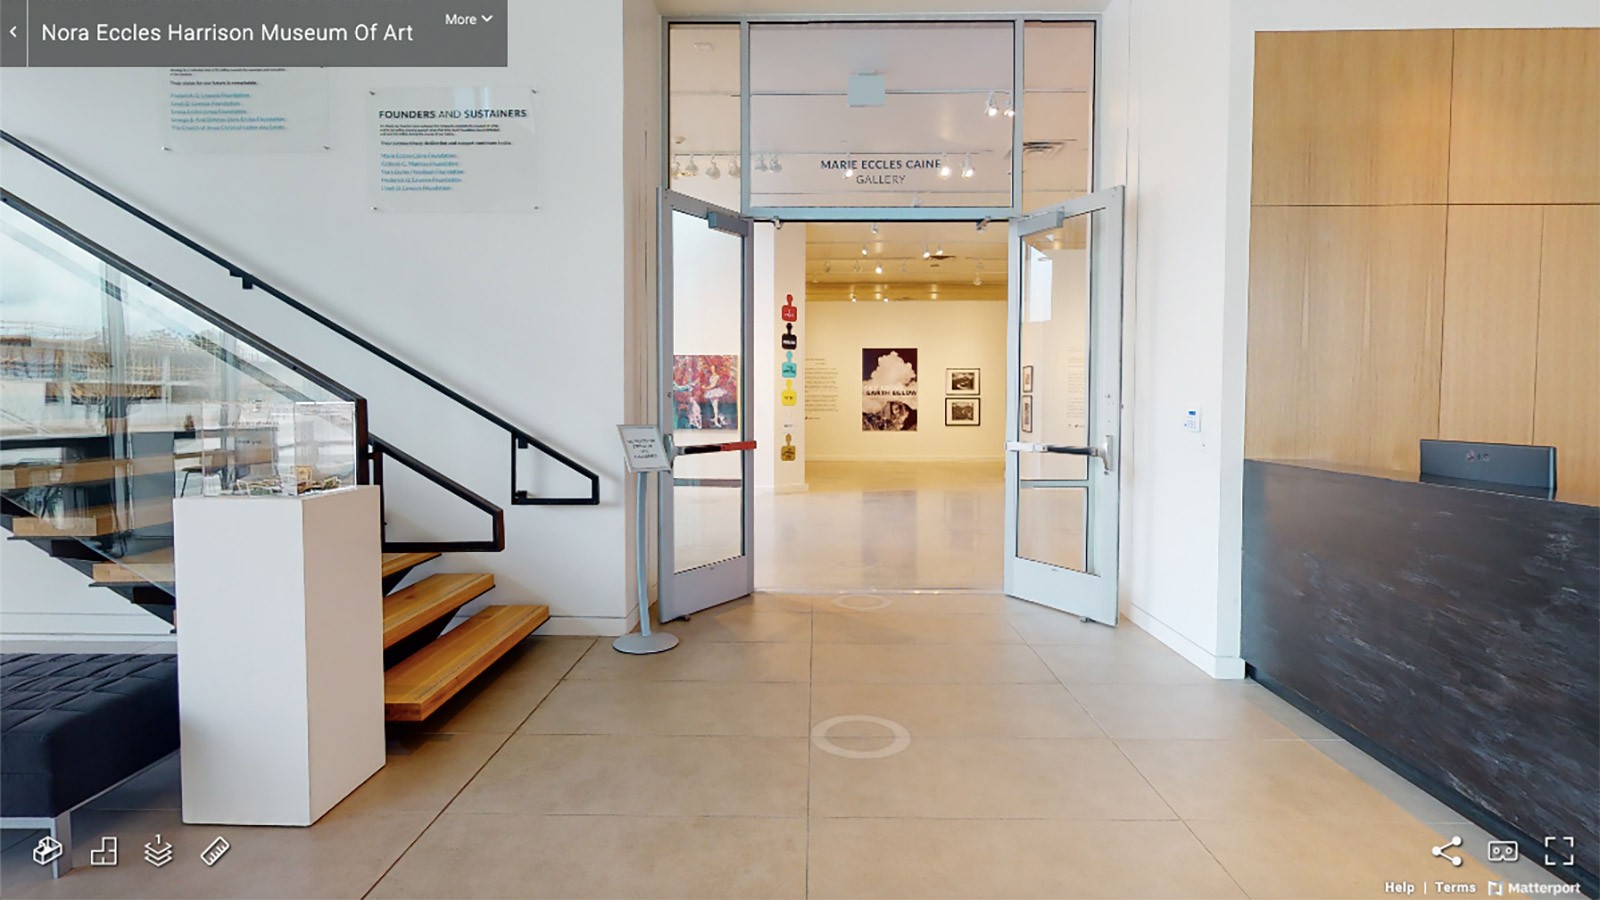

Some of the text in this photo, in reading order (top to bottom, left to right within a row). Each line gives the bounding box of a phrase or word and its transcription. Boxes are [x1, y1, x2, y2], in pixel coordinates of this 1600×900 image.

[378, 109, 527, 119] FOUNDERS AND SUSTAINERS
[820, 159, 941, 170] MARIE ECCLES CAINE
[856, 175, 906, 184] GALLERY
